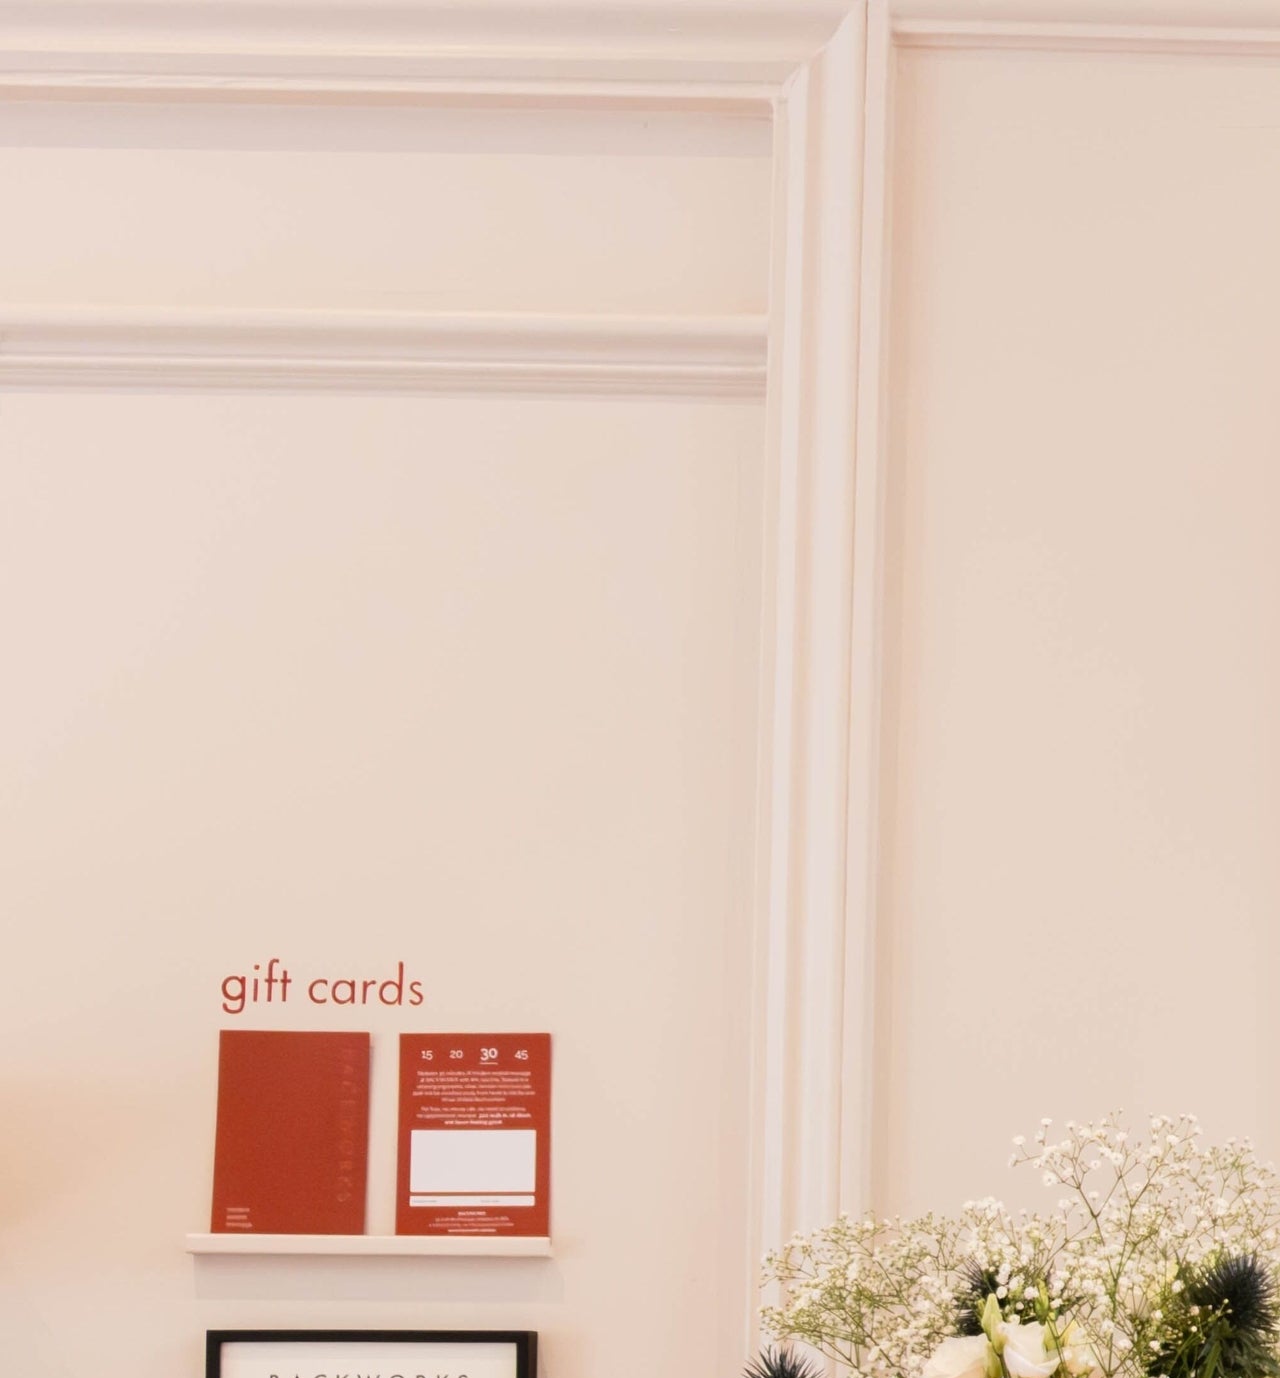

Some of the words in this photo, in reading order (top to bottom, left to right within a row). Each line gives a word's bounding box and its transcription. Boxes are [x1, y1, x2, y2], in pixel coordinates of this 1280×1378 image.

[221, 958, 292, 1014] gift
[307, 961, 424, 1006] cards
[421, 1050, 433, 1060] 15
[449, 1049, 463, 1058] 20
[480, 1048, 498, 1062] 30
[514, 1049, 528, 1060] 45
